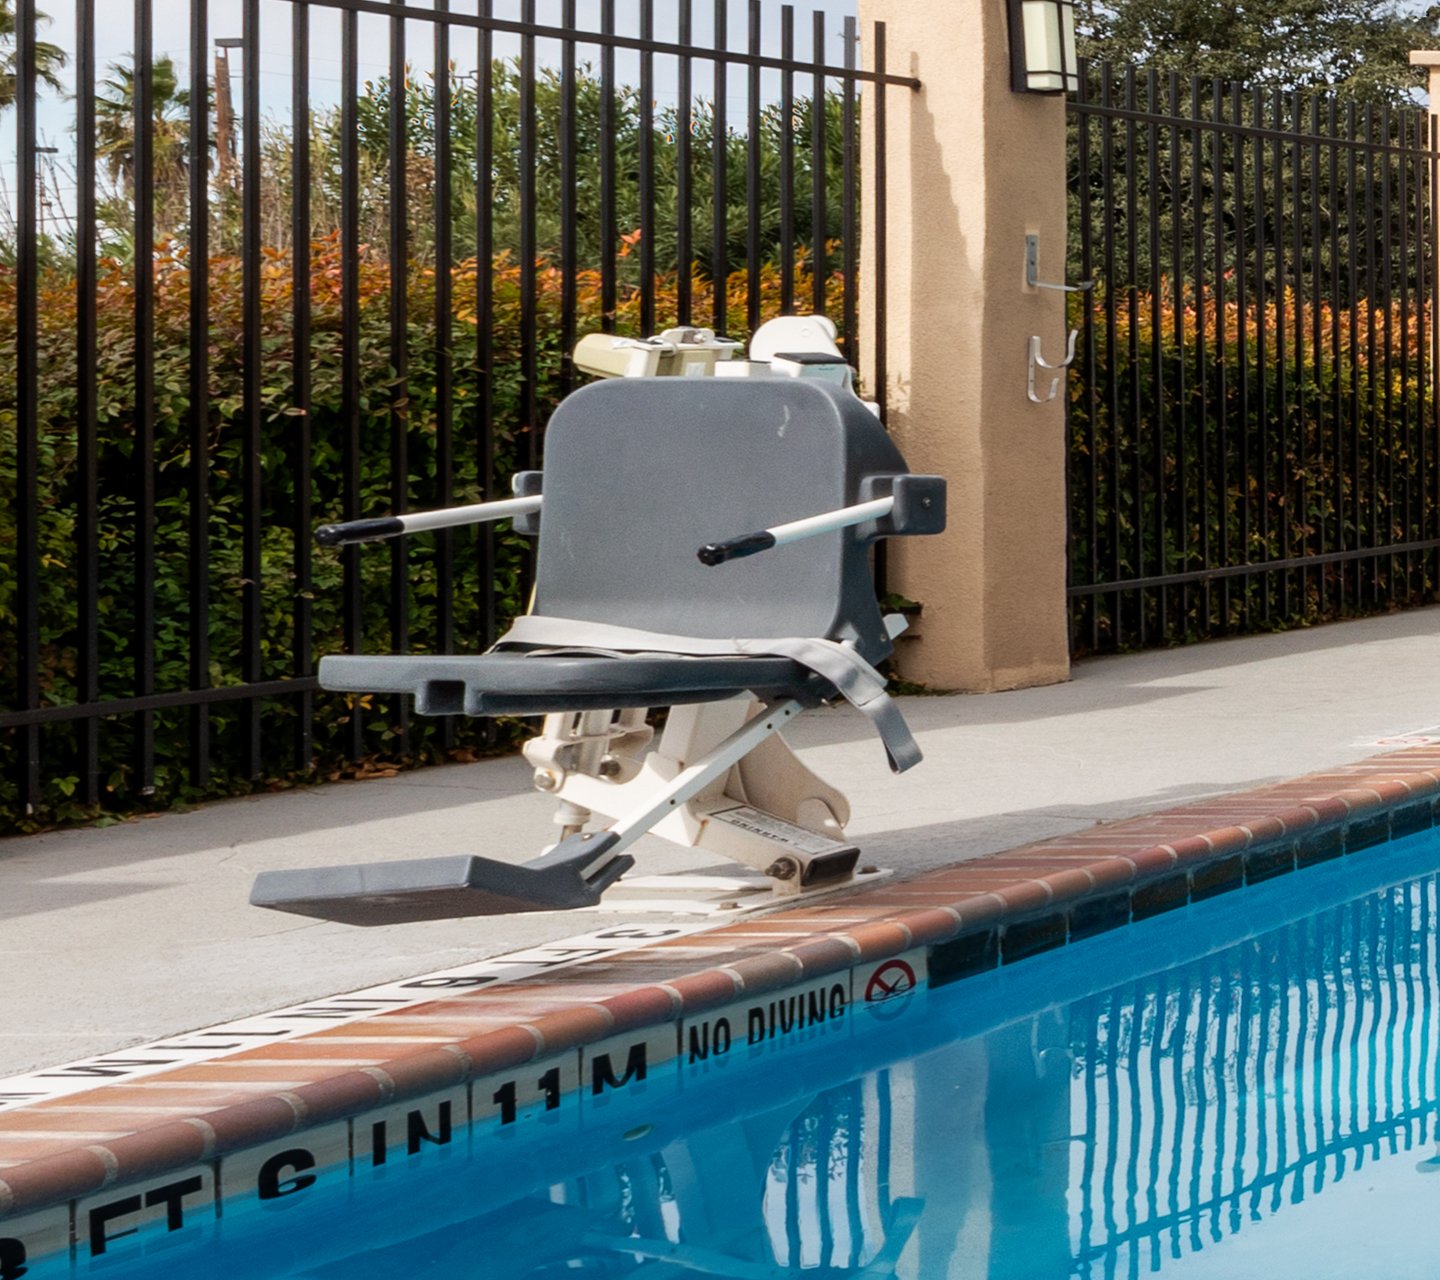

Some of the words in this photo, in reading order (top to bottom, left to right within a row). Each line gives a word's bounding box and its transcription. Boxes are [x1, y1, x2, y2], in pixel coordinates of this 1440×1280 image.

[89, 1175, 202, 1257] FT
[258, 1148, 317, 1200] 6
[373, 1100, 452, 1166] IN
[592, 1042, 647, 1095] M
[689, 1017, 731, 1064] NO
[748, 983, 845, 1046] DIVING
